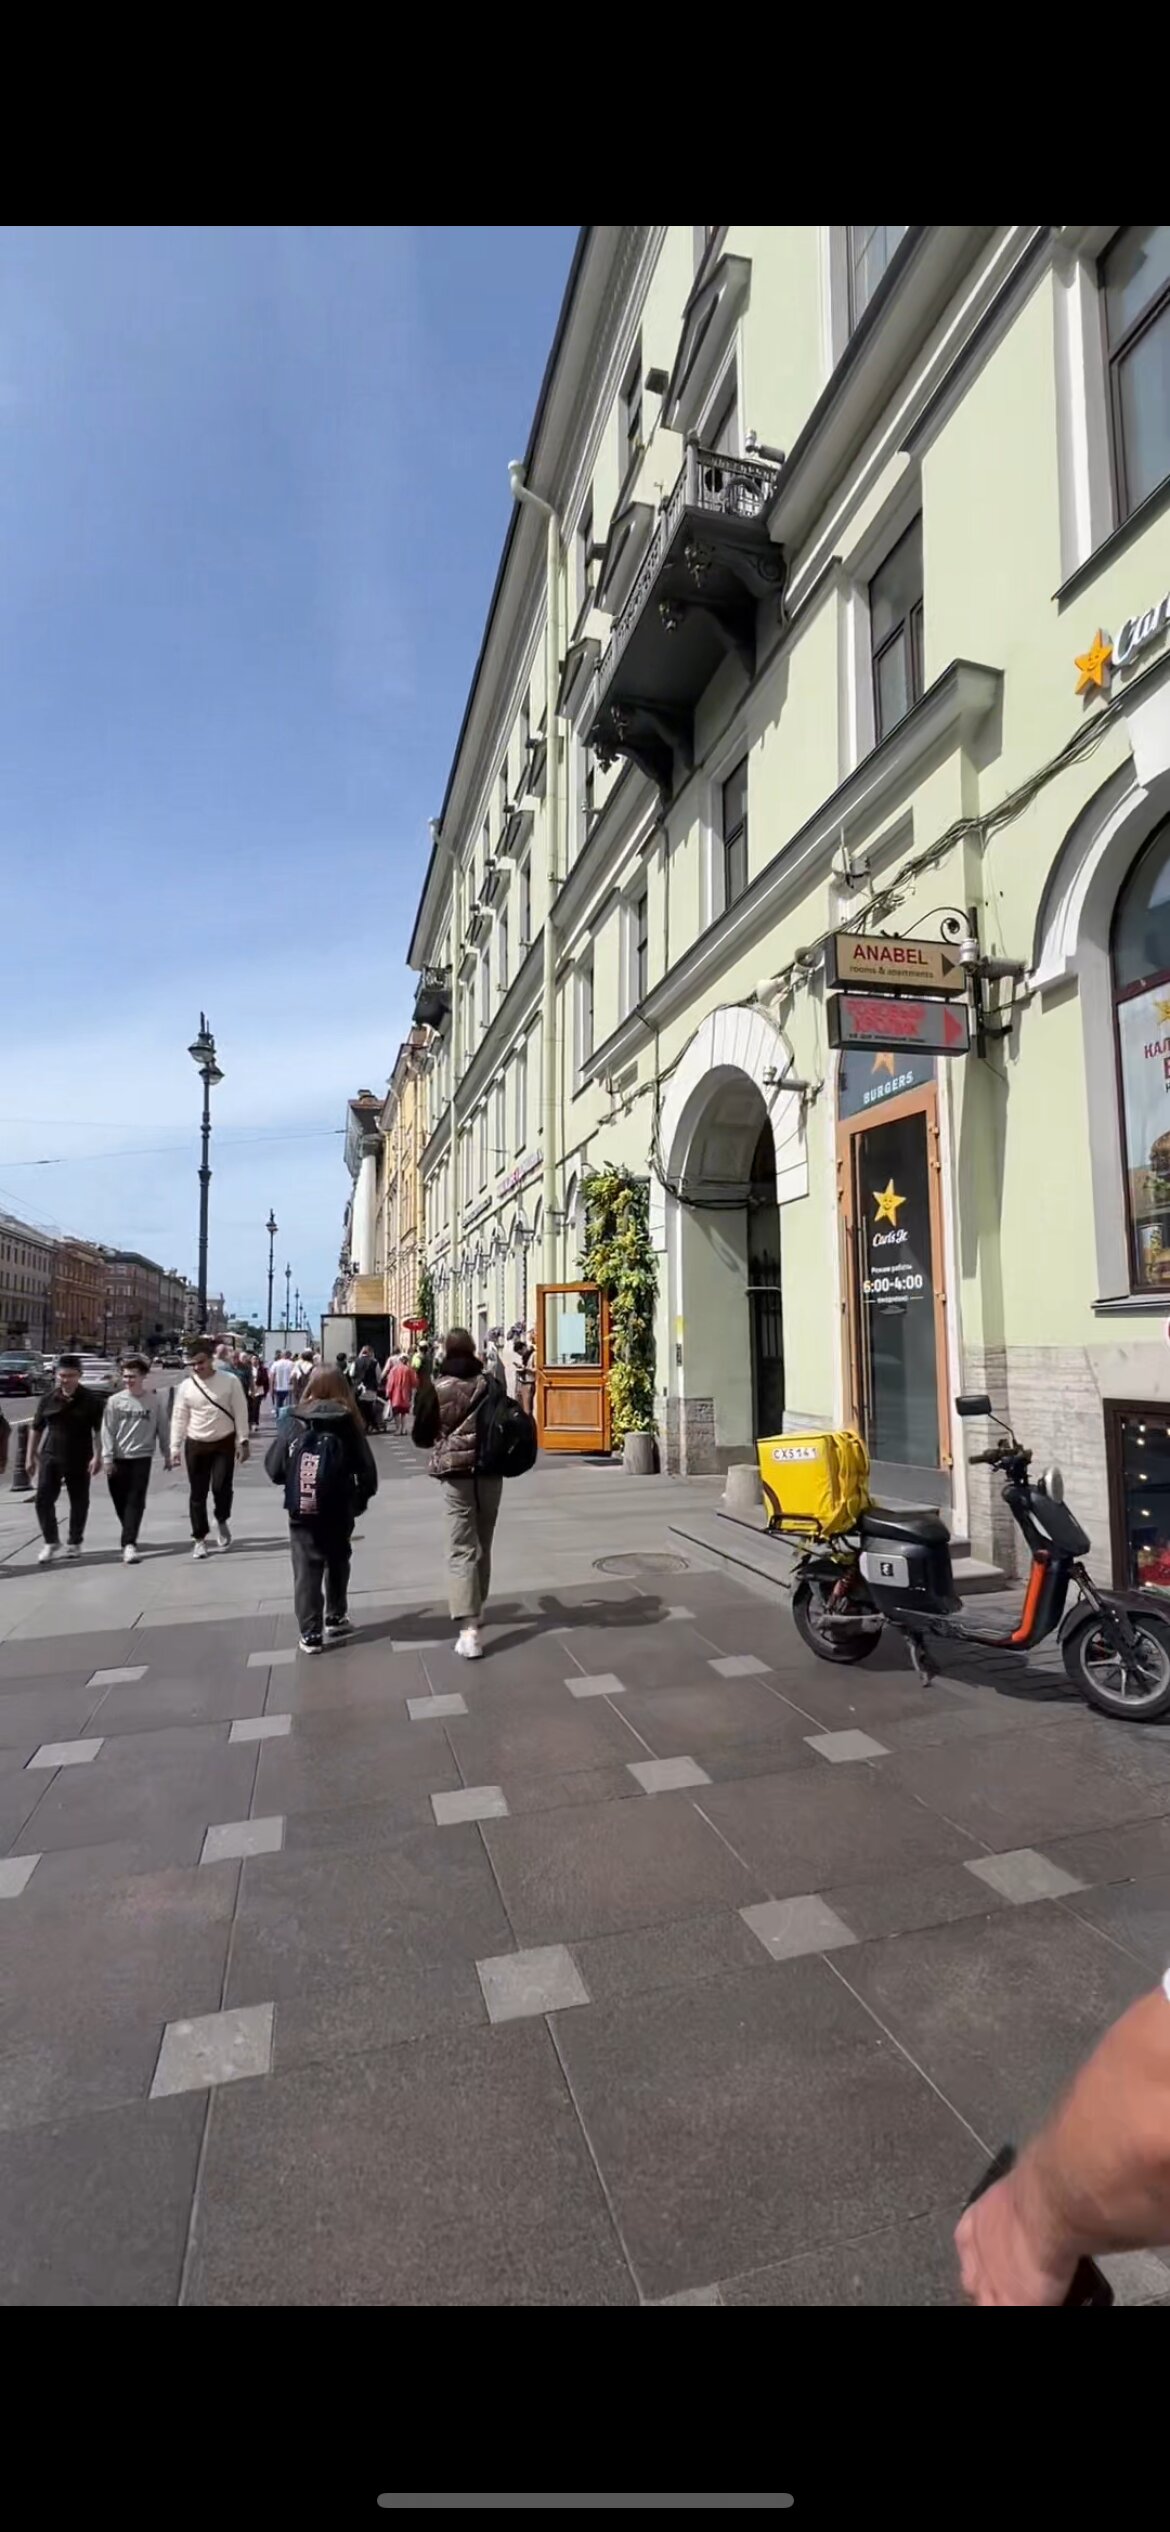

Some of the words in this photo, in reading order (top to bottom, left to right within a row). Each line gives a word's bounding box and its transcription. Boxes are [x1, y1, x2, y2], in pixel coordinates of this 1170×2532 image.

[853, 944, 928, 965] ANABEL
[849, 965, 877, 974] rooms
[878, 966, 886, 975] &
[887, 968, 934, 979] apartments
[864, 1071, 914, 1104] BURGERS
[863, 1274, 922, 1293] 6:00-4:00
